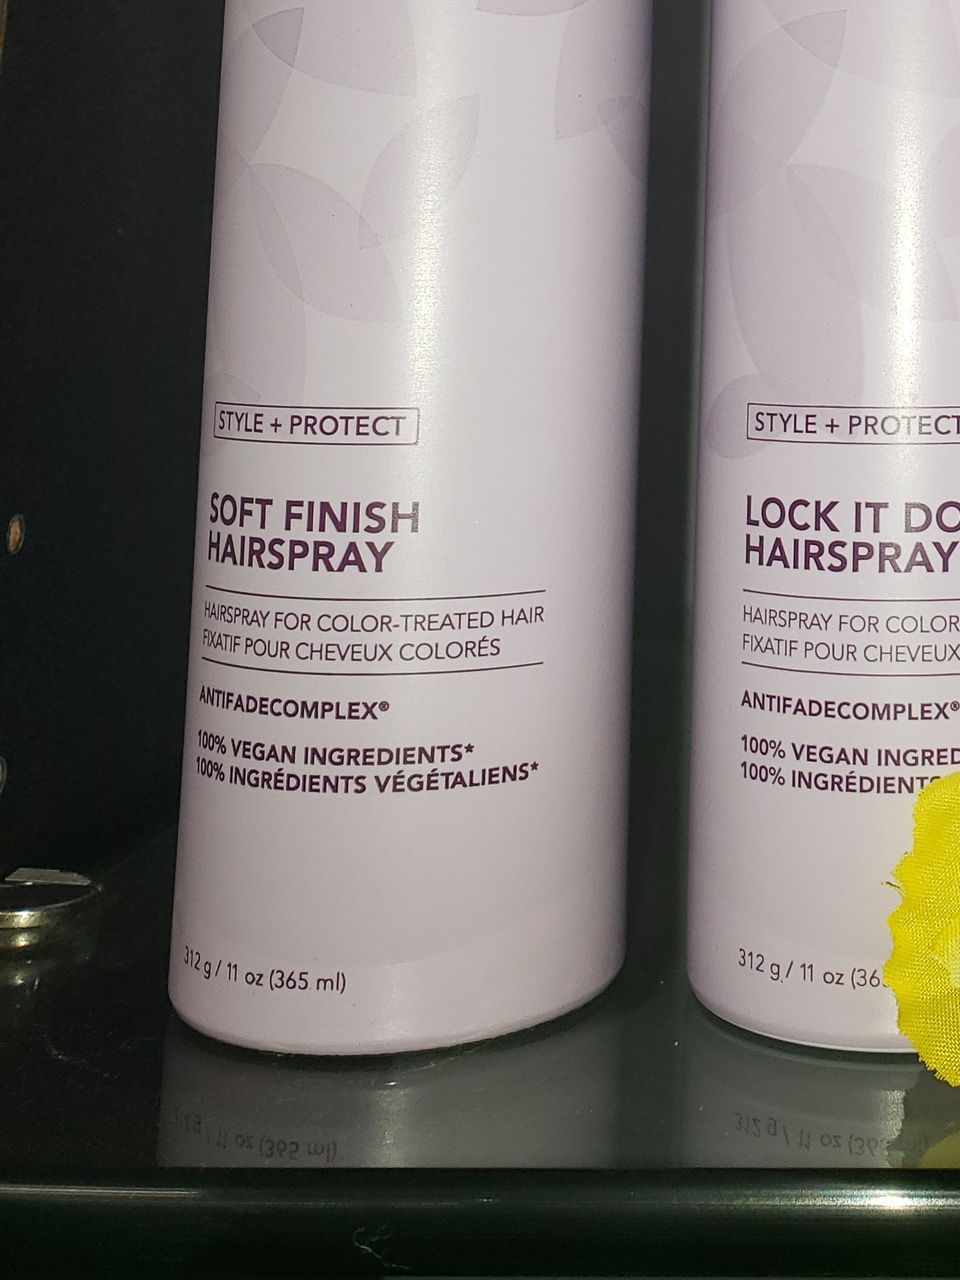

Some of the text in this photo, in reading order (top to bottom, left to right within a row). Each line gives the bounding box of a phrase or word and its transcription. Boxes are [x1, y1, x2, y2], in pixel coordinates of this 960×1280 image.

[218, 411, 406, 436] STYLE + PROTECT
[755, 412, 817, 434] STYLE
[825, 419, 840, 434] +
[209, 492, 420, 533] SOFT FINISH
[746, 495, 840, 533] LOCK
[853, 501, 889, 533] IT
[207, 531, 395, 573] HAIRSPRAY
[744, 533, 960, 573] HAIRSPRAY
[204, 601, 545, 632] HAIRSPRAY FOR COLOR-TREATED HAIR
[743, 604, 832, 631] HAIRSPRAY
[839, 613, 879, 632] FOR
[202, 629, 500, 661] FIXATIF POUR CHEVEUX COLORÉS
[742, 634, 798, 657] FIXATIF
[804, 641, 857, 661] POUR
[863, 643, 960, 662] CHEVEUX
[198, 729, 226, 754] 100%
[231, 738, 296, 764] VEGAN
[741, 734, 785, 758] 100%
[791, 743, 869, 766] VEGAN
[196, 756, 225, 782] 100%
[229, 765, 366, 794] INGRÉDIENTS
[741, 761, 785, 786] 100%
[184, 945, 200, 970] 312
[226, 962, 238, 982] 11
[245, 972, 263, 986] oz
[269, 969, 309, 991] (365
[316, 971, 347, 995] ml)
[738, 948, 765, 972] 312
[800, 963, 814, 982] 11
[823, 971, 845, 985] oz
[851, 967, 889, 990] (36
